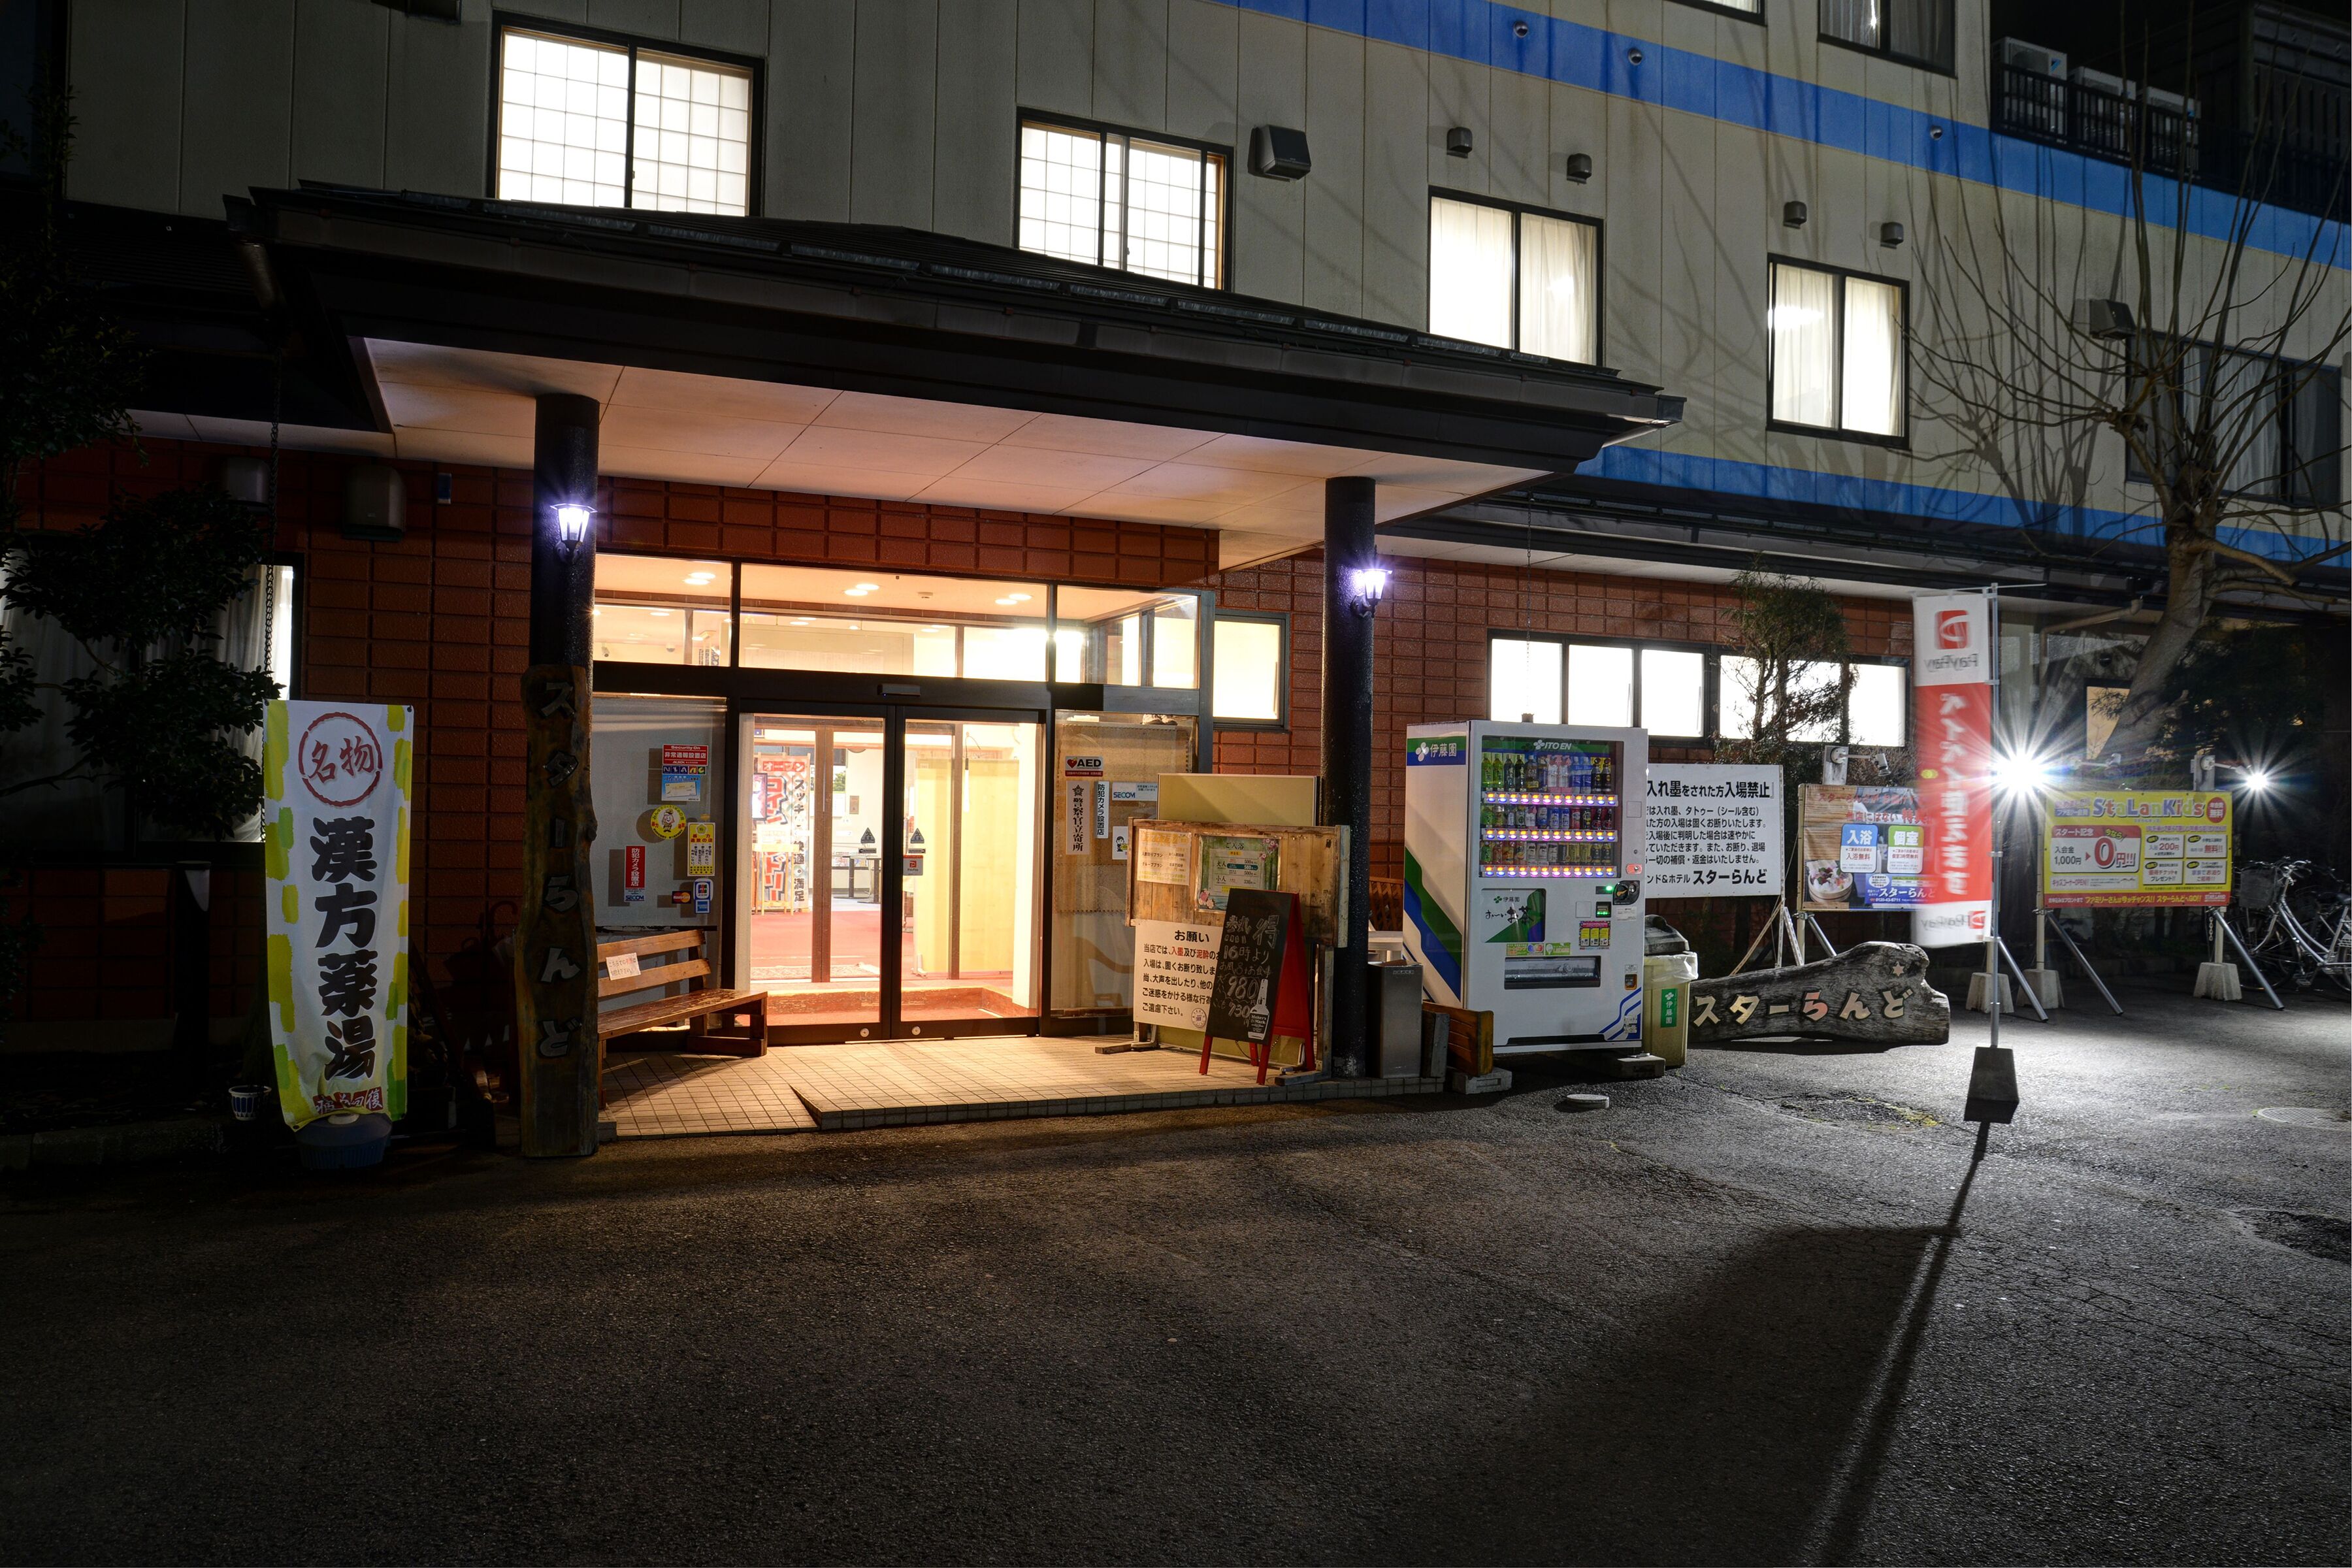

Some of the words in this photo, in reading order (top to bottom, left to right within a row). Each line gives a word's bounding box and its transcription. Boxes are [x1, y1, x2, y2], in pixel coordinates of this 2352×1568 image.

[1430, 743, 1457, 758] 伊藤園
[311, 737, 376, 782] 名物
[764, 762, 804, 771] オープン
[1077, 759, 1102, 767] AED
[2093, 797, 2205, 817] StaLanKids
[2210, 809, 2223, 818] 無料
[1073, 798, 1083, 851] 警察官立寄所
[1847, 830, 1872, 845] 入浴
[1894, 831, 1919, 846] 個室
[540, 682, 581, 1057] スターらんど
[631, 848, 640, 887] 防犯カメラ設置店
[2054, 856, 2082, 866] 1,000円
[1693, 868, 1767, 885] スターらんど
[1175, 930, 1210, 942] お願い
[311, 816, 378, 1081] 漢方薬湯
[1223, 945, 1269, 964] 16時より
[1143, 958, 1216, 975] 入場は、固くお断り致しま
[1143, 973, 1213, 990] 尚、大声を出したり、他の
[1143, 1002, 1184, 1017] ご遠慮下さい。
[1693, 988, 1914, 1027] スターらんど
